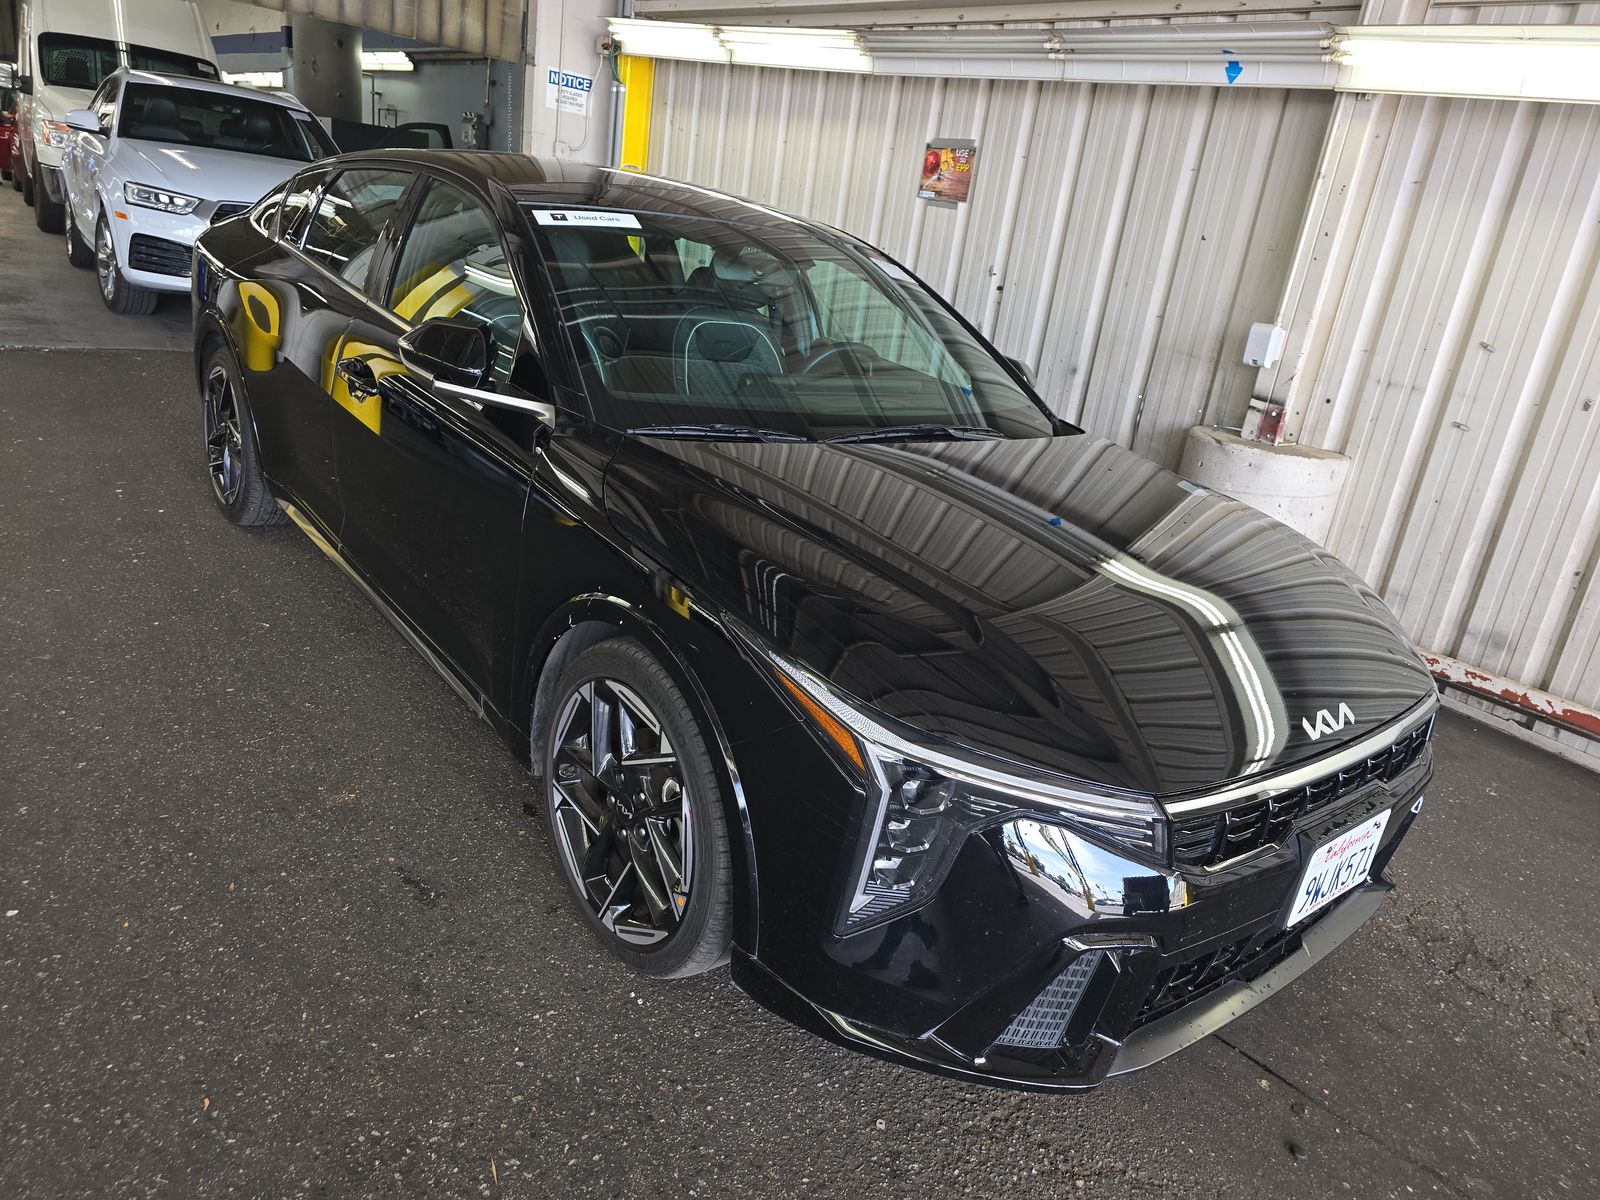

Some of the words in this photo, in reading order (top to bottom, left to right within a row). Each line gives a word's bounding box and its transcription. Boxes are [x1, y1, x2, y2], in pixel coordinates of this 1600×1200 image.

[550, 71, 591, 91] NOTICE
[955, 148, 970, 158] USE
[955, 163, 970, 173] EPP
[1302, 702, 1355, 741] KIA
[1325, 830, 1373, 863] California
[1297, 842, 1375, 914] 9WJK571
